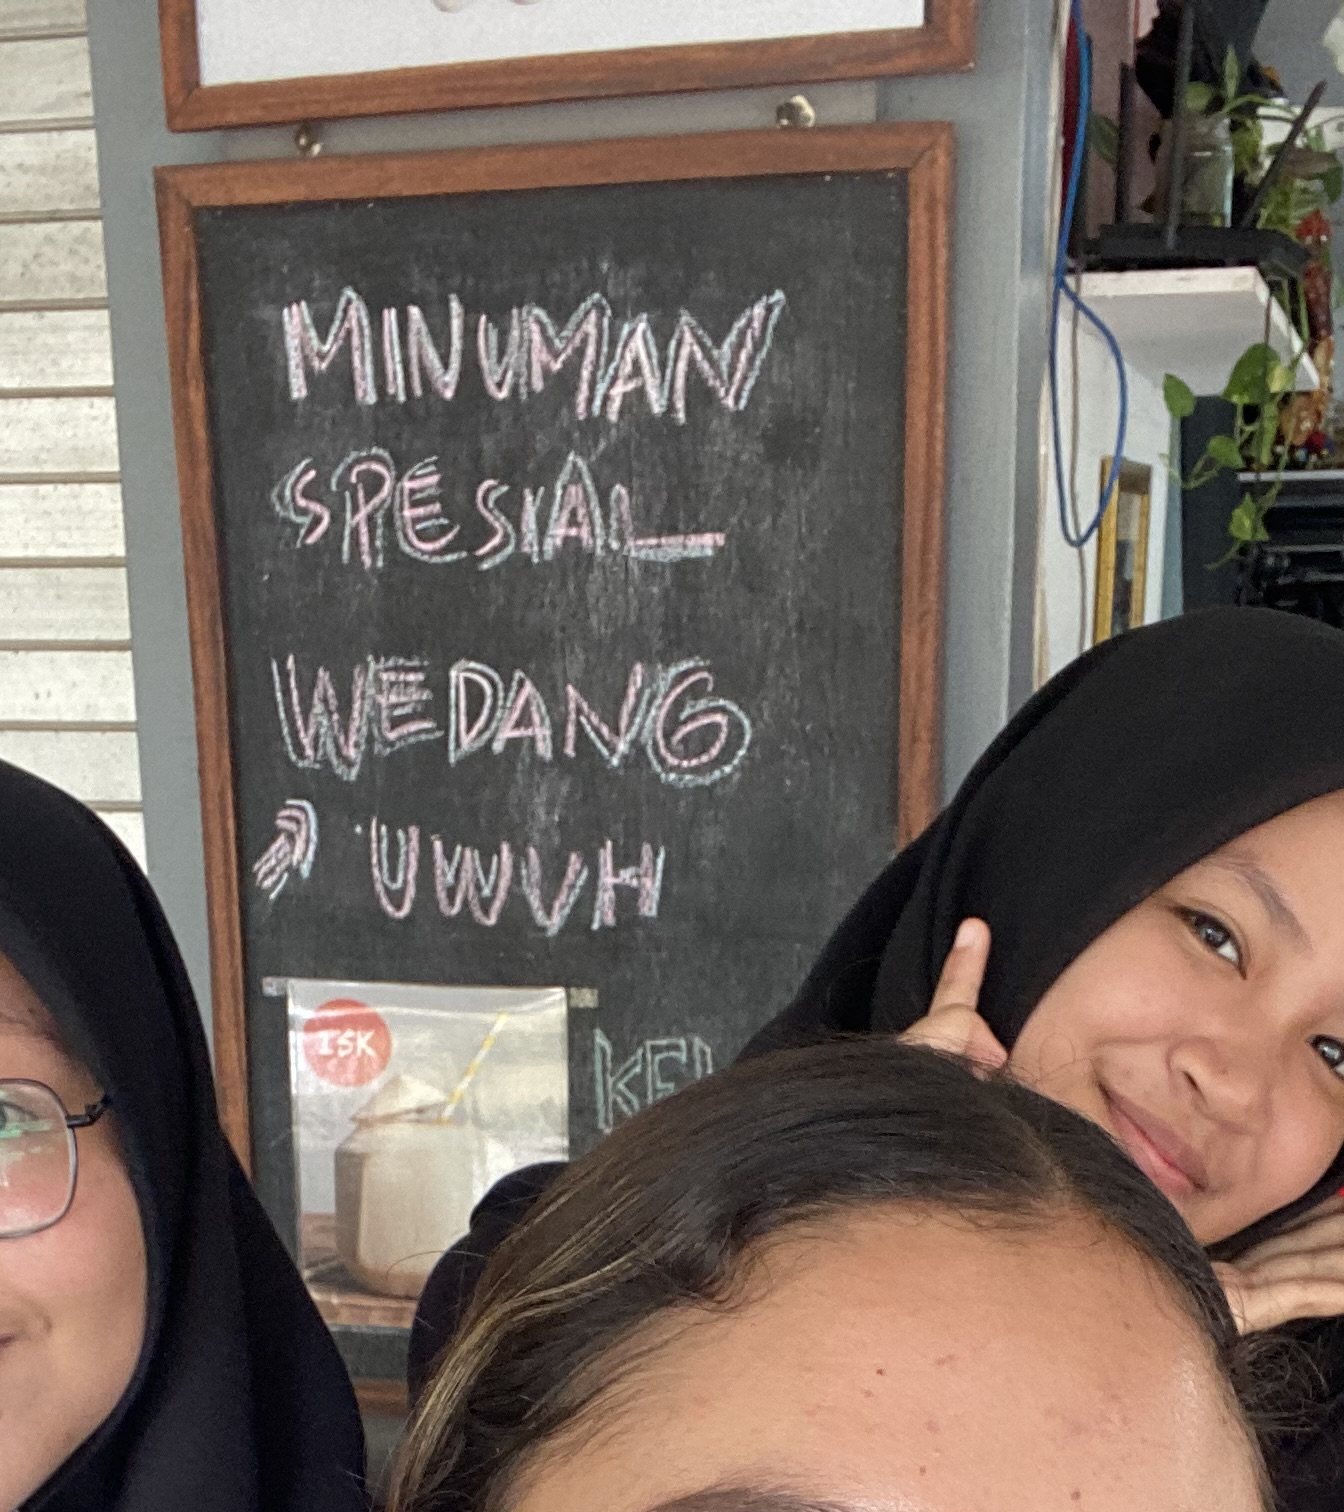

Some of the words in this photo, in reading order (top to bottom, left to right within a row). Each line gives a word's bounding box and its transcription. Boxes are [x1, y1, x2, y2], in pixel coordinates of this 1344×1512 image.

[282, 286, 787, 425] MINUMAN
[272, 446, 727, 572] SPESIAL
[271, 652, 754, 788] WEDANG
